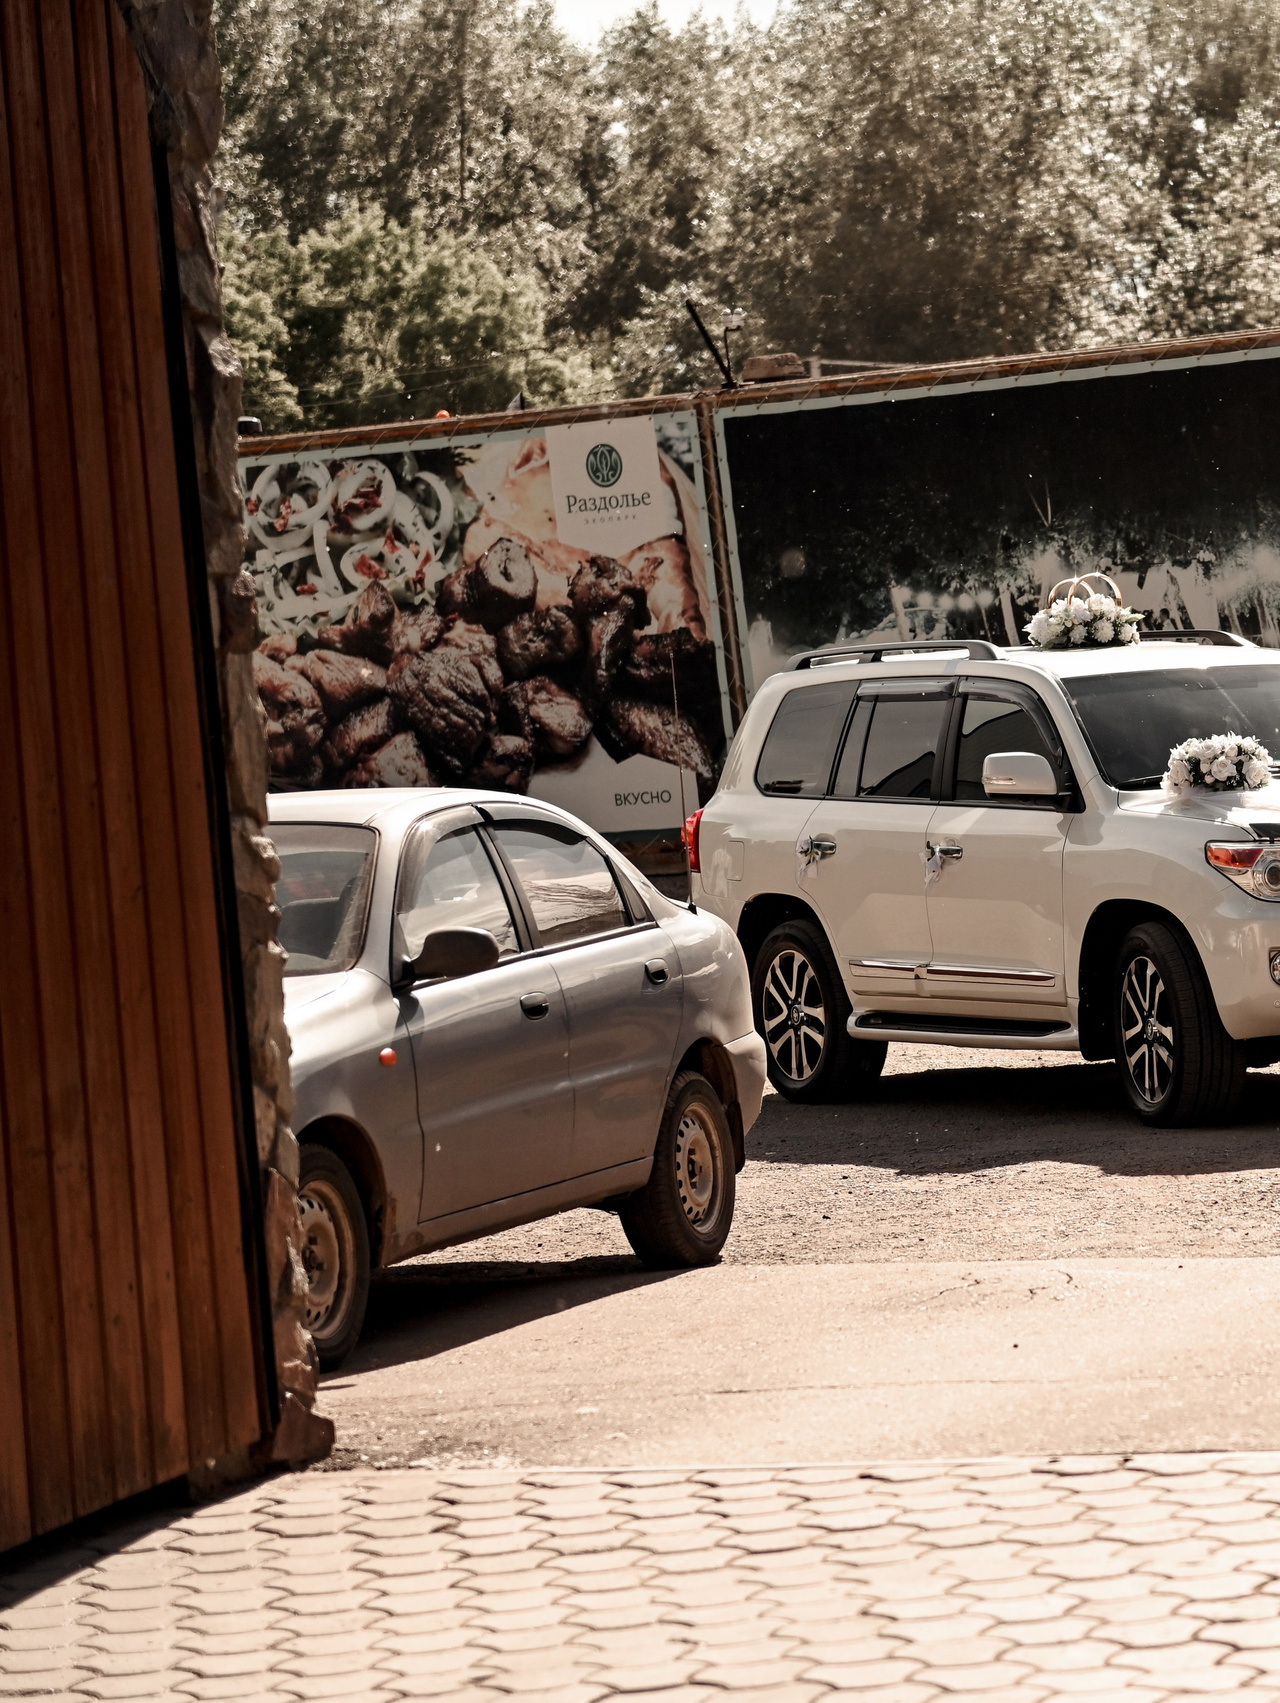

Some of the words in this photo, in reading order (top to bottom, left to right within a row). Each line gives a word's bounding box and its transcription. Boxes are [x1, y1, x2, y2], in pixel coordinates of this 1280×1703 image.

[566, 492, 652, 514] Раздолье
[584, 514, 637, 525] ЭКОПАРК
[614, 789, 672, 807] ВКУСНО
